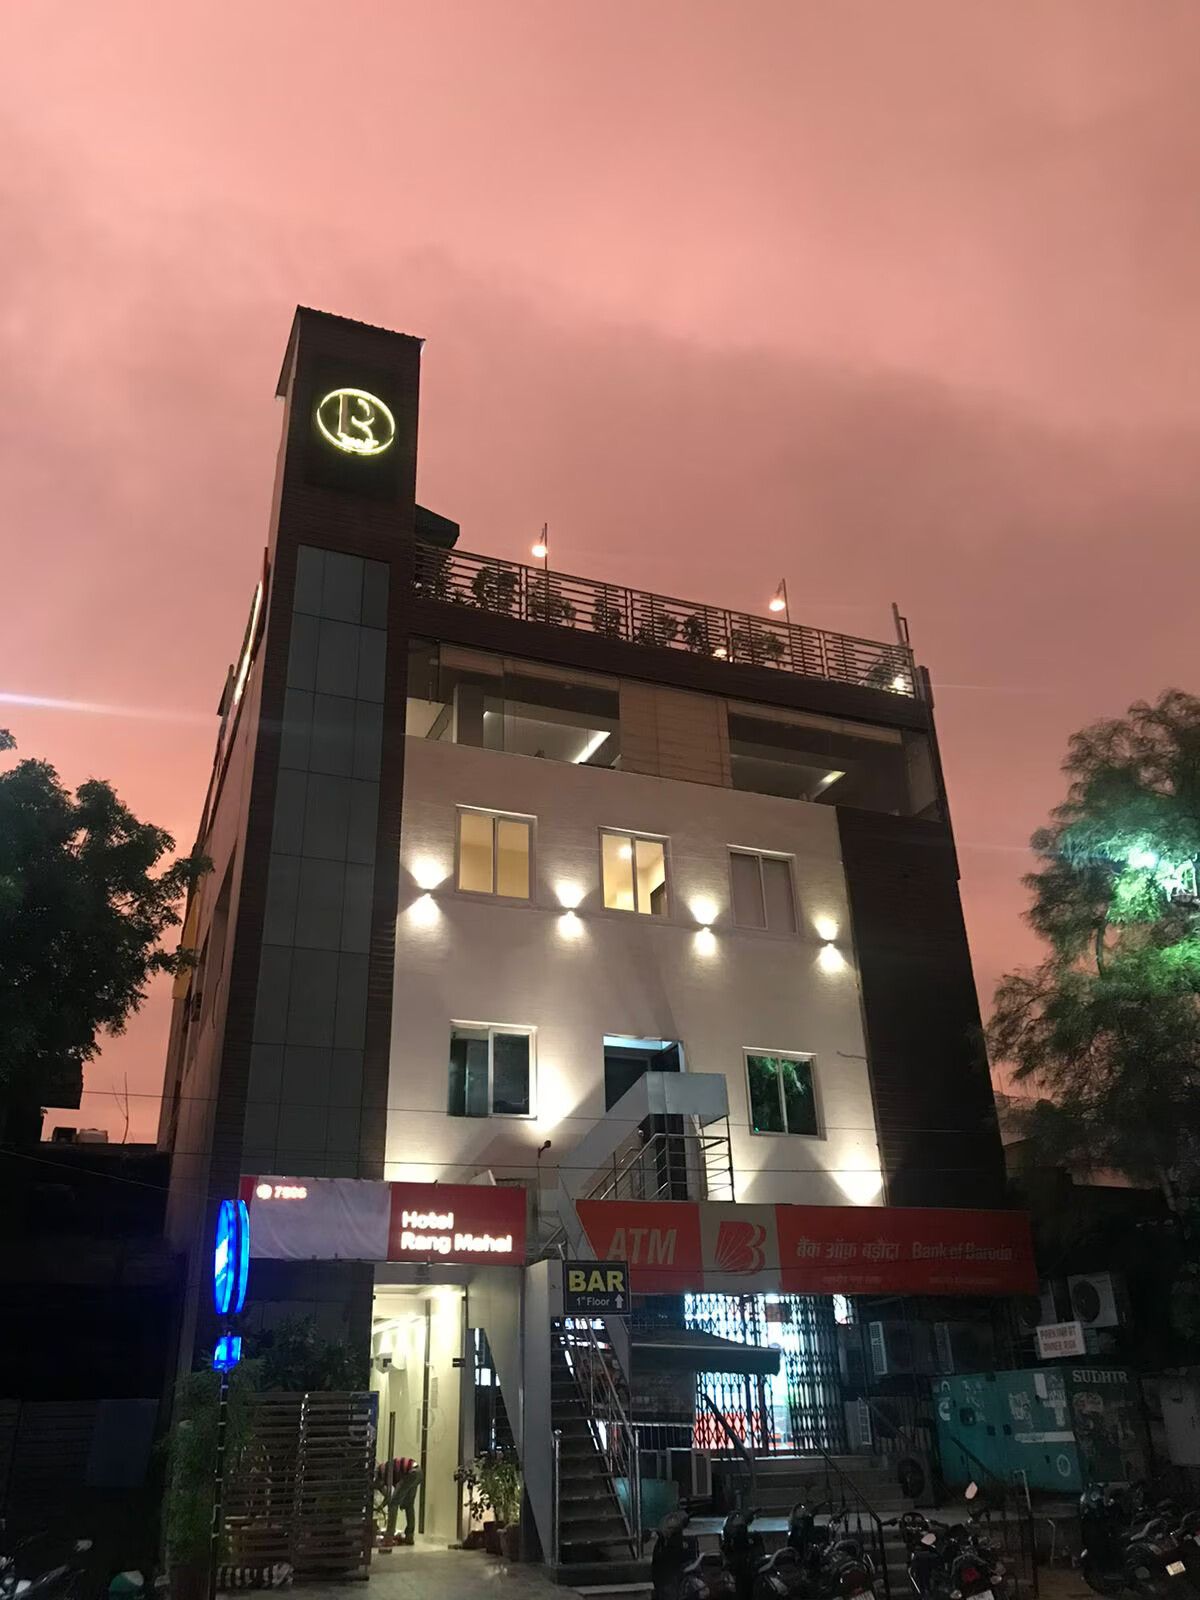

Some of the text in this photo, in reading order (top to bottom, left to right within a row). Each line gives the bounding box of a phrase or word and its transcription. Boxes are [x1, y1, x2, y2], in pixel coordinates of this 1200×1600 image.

[402, 1210, 454, 1230] Hotel
[401, 1231, 512, 1254] Rang Mahal
[606, 1229, 677, 1264] ATM
[912, 1241, 1012, 1261] Bank of Baroda
[568, 1270, 625, 1293] BAR
[586, 1297, 610, 1306] Floor
